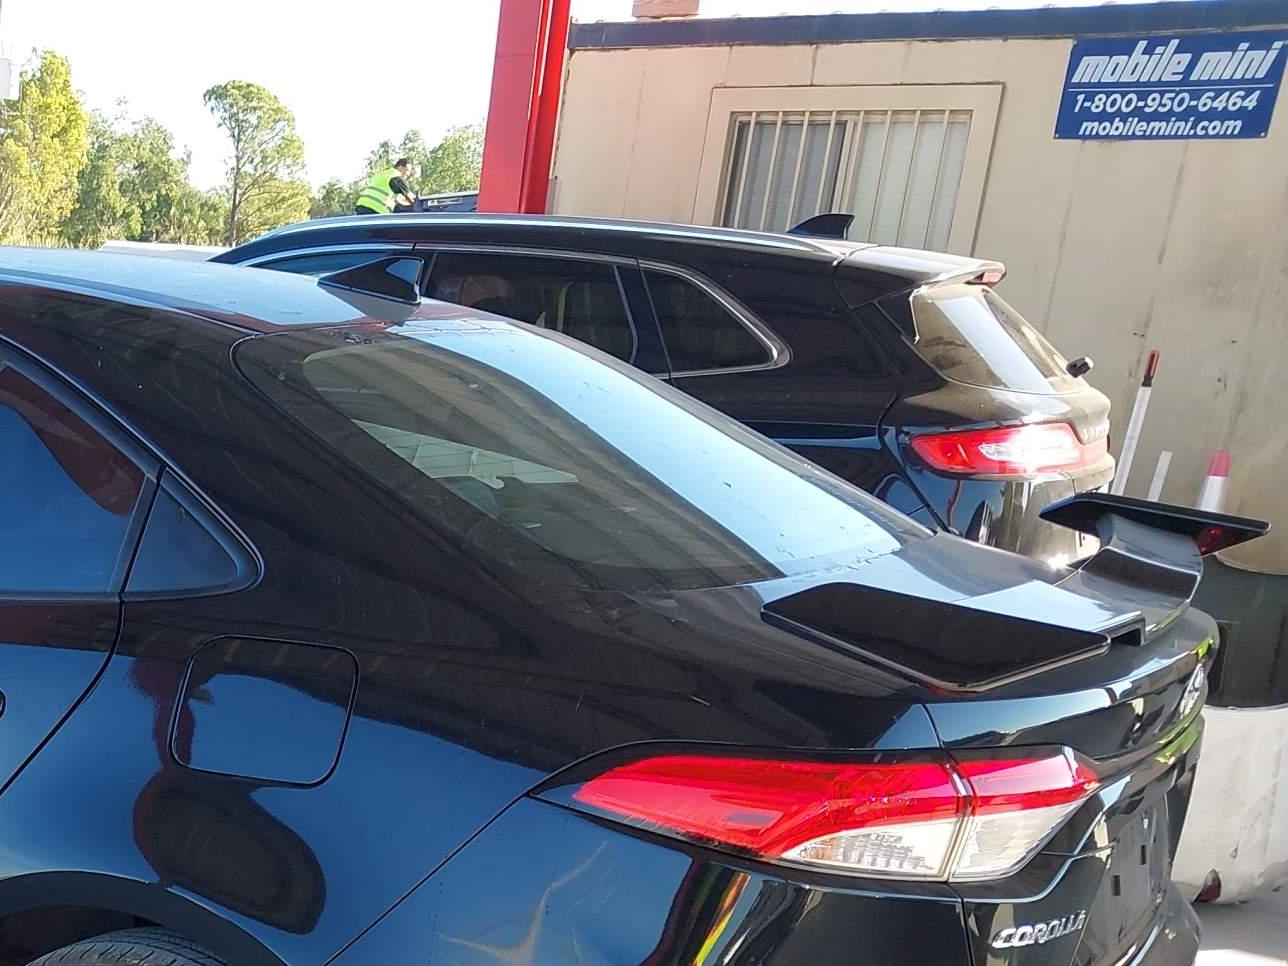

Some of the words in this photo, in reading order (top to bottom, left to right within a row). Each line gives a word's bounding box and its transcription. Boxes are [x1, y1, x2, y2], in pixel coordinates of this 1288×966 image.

[1071, 39, 1192, 83] mobile
[1189, 41, 1284, 81] mini
[1073, 90, 1261, 113] 1-800-950-6464
[1078, 117, 1243, 136] mobilemini.com
[992, 909, 1086, 949] COROLLA
